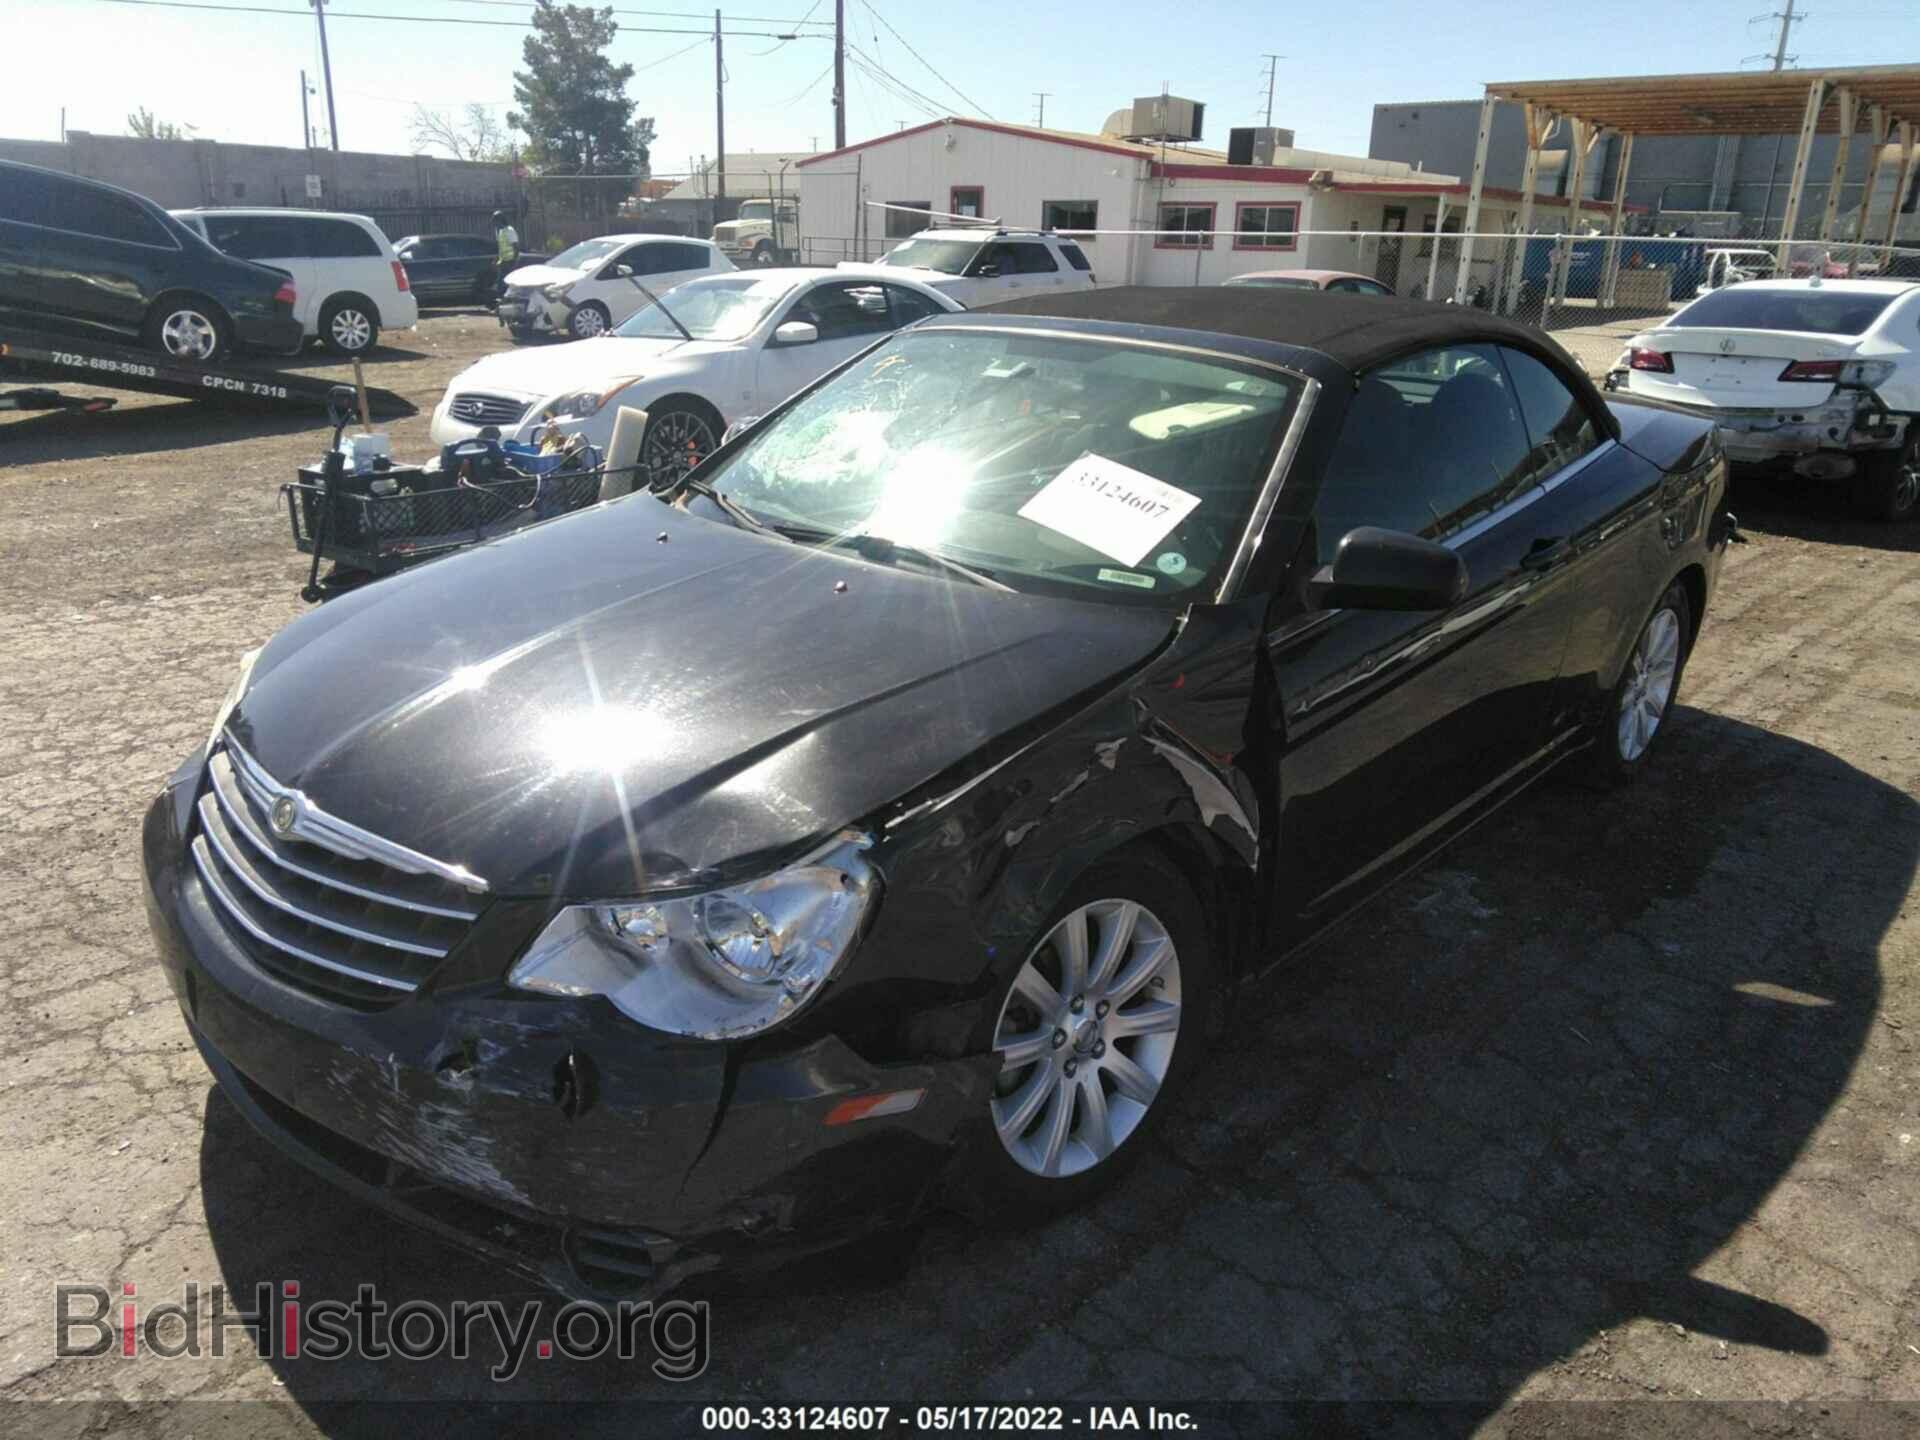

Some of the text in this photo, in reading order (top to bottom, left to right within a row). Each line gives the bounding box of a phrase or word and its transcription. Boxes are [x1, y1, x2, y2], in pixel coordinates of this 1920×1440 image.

[52, 352, 156, 377] 702-689-5983
[202, 375, 287, 398] CPCN 7318
